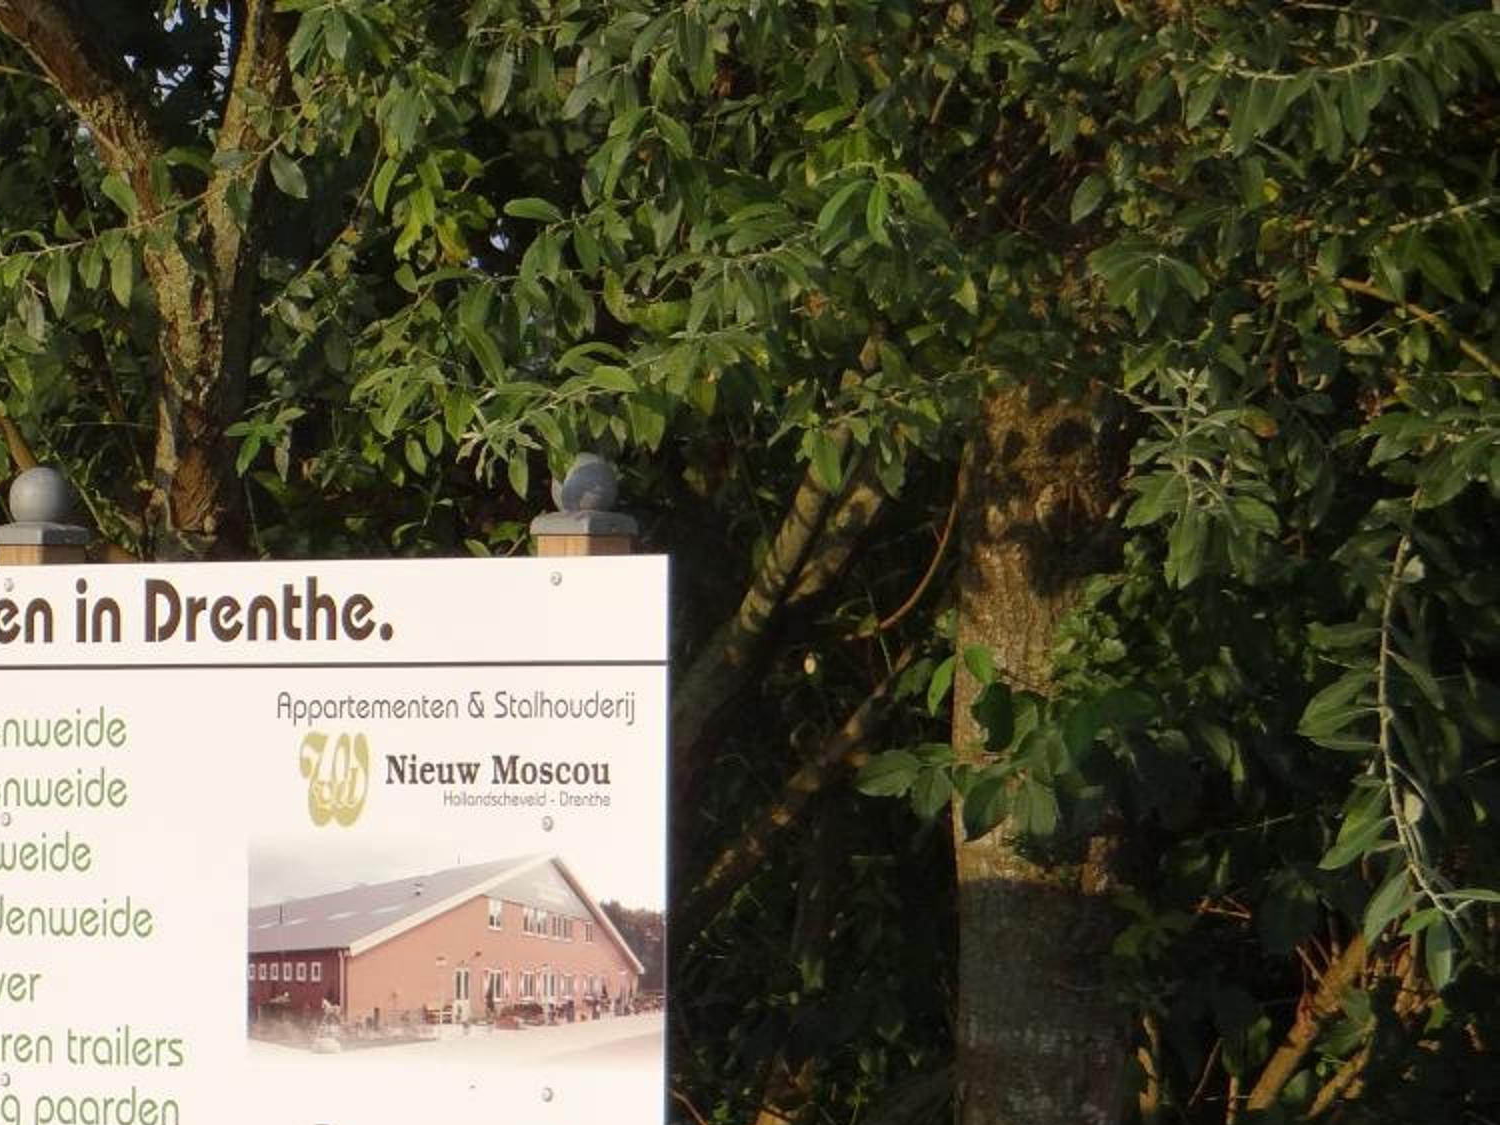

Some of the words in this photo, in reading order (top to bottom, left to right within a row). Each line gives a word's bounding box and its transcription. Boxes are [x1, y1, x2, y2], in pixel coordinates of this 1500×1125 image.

[76, 578, 121, 643] in
[145, 576, 394, 642] Drenthe.
[277, 692, 458, 726] Appartementen
[468, 691, 484, 718] &
[494, 690, 634, 726] Stalhouderij
[386, 754, 480, 784] Nieuw
[492, 755, 611, 785] Moscou
[68, 1024, 184, 1067] trailers
